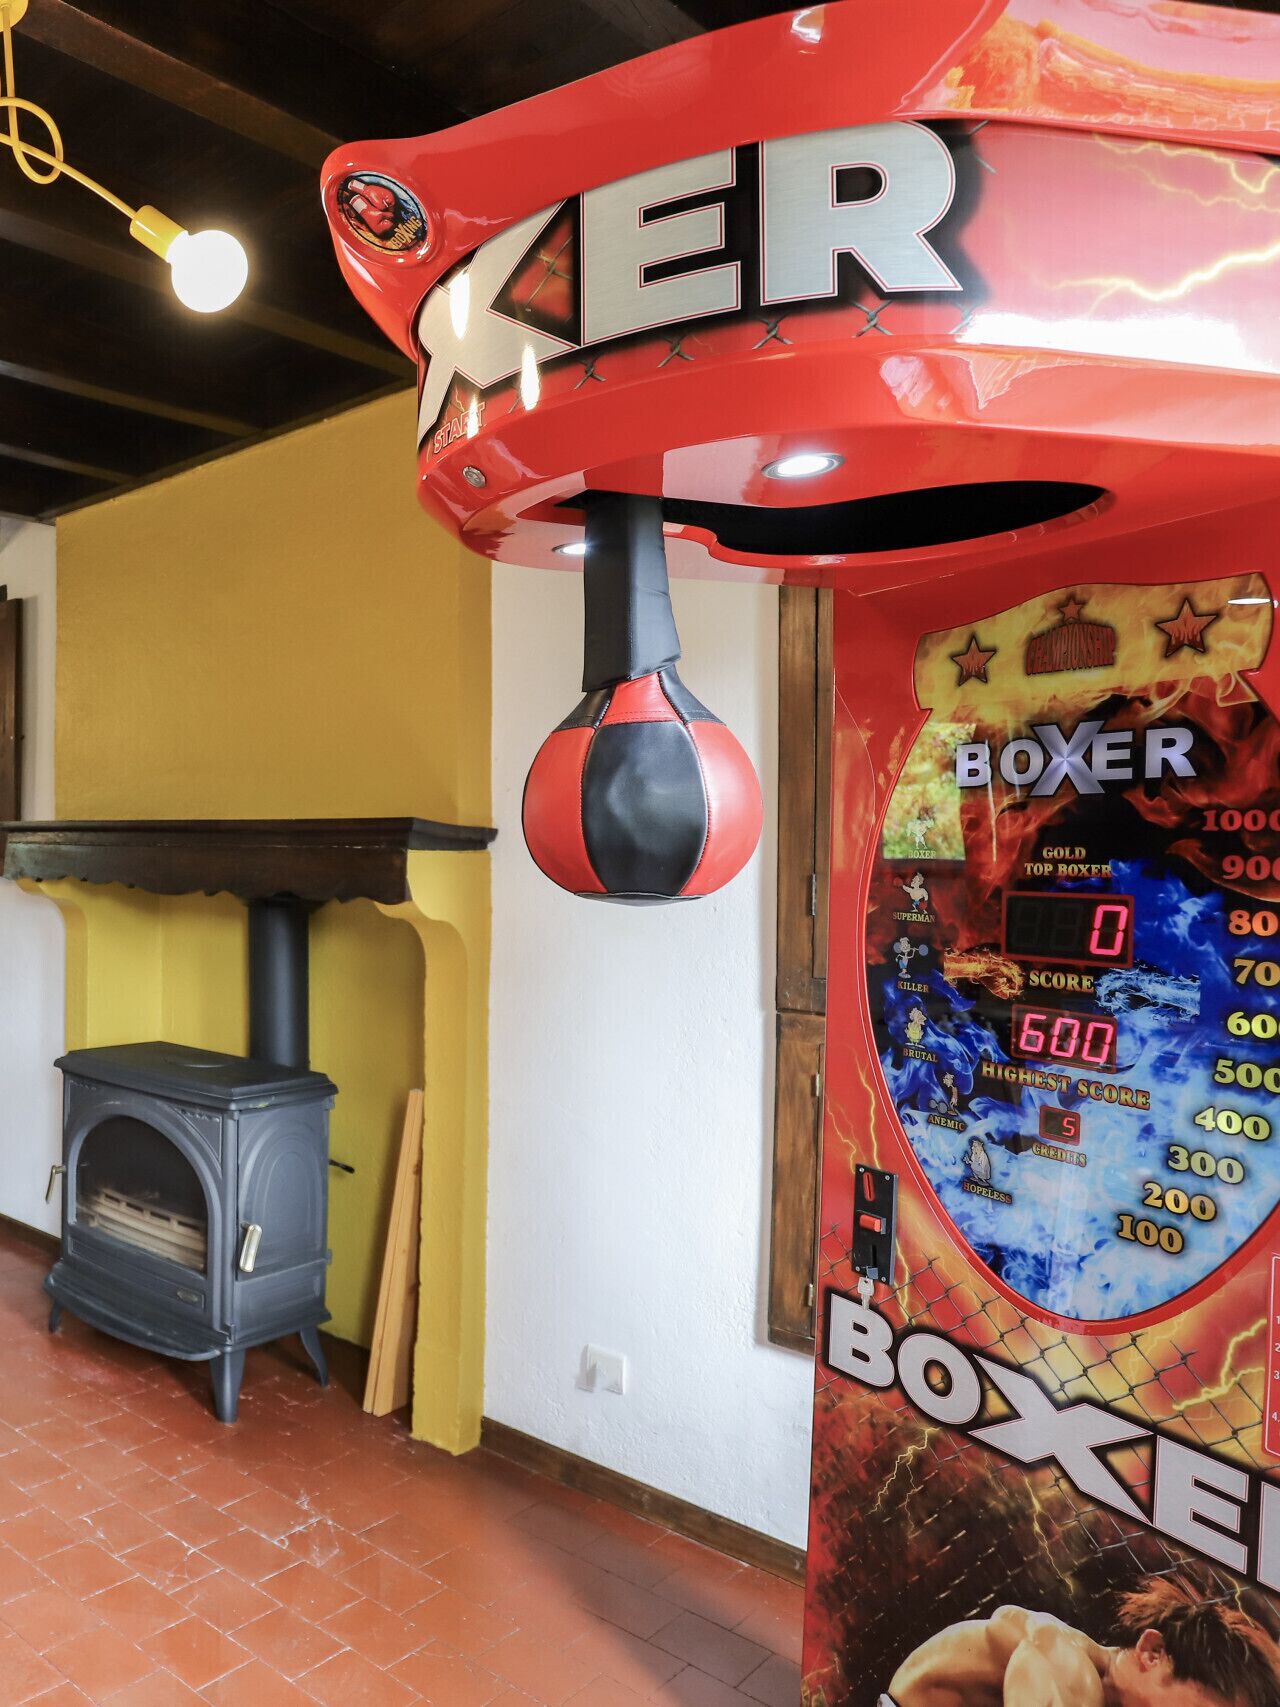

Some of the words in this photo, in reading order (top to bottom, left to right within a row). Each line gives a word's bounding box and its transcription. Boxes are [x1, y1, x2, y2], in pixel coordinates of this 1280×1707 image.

[955, 720, 1197, 797] BOXER
[908, 849, 937, 859] BOXER
[1042, 846, 1087, 860] GOLD
[1024, 862, 1054, 876] TOP
[1057, 863, 1112, 878] BOXER
[892, 911, 936, 923] SUPERMAN
[1089, 904, 1128, 956] 0
[897, 980, 929, 993] KILLER
[1029, 970, 1095, 993] SCORE
[1019, 1013, 1114, 1064] 600
[1227, 1011, 1280, 1039] 60
[903, 1048, 937, 1063] BRUTAL
[981, 1060, 1071, 1095] HIGHEST
[1076, 1078, 1151, 1111] SCORE
[928, 1114, 966, 1132] ANEMIC
[1194, 1107, 1271, 1141] 400
[1032, 1142, 1087, 1168] CREDITS
[1167, 1145, 1245, 1184] 300
[963, 1181, 1013, 1205] HOPELESS
[1143, 1182, 1217, 1221] 200
[1118, 1214, 1184, 1254] 100
[829, 1293, 1280, 1593] BOXE
